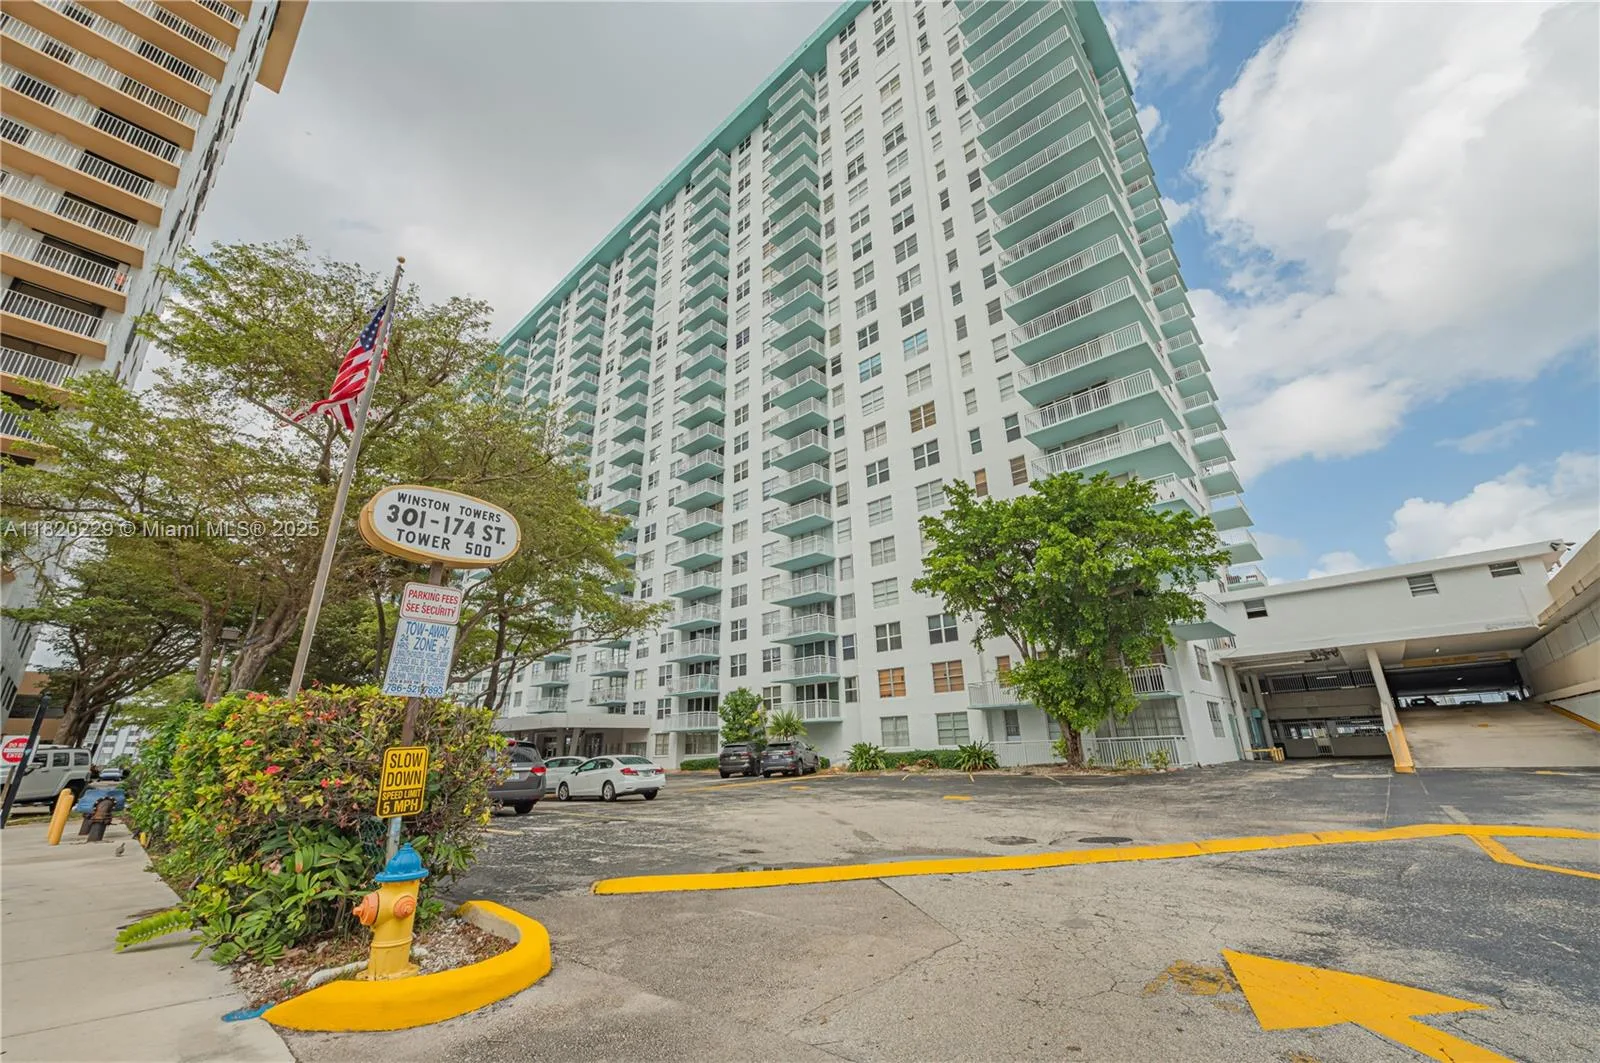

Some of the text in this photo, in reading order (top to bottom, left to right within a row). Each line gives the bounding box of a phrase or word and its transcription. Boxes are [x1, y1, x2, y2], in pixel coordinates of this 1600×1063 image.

[397, 492, 501, 523] WINSTON TOWERS
[387, 504, 505, 545] 301-174 ST.
[397, 528, 492, 558] TOWER 500
[408, 590, 459, 605] PARKING FEES
[406, 603, 456, 617] SEE SECURITY
[413, 636, 438, 652] ZONE
[389, 752, 423, 769] SLOW
[386, 770, 422, 787] DOWN
[382, 789, 422, 801] SPEED LIMIT
[382, 798, 419, 815] 5 MPH
